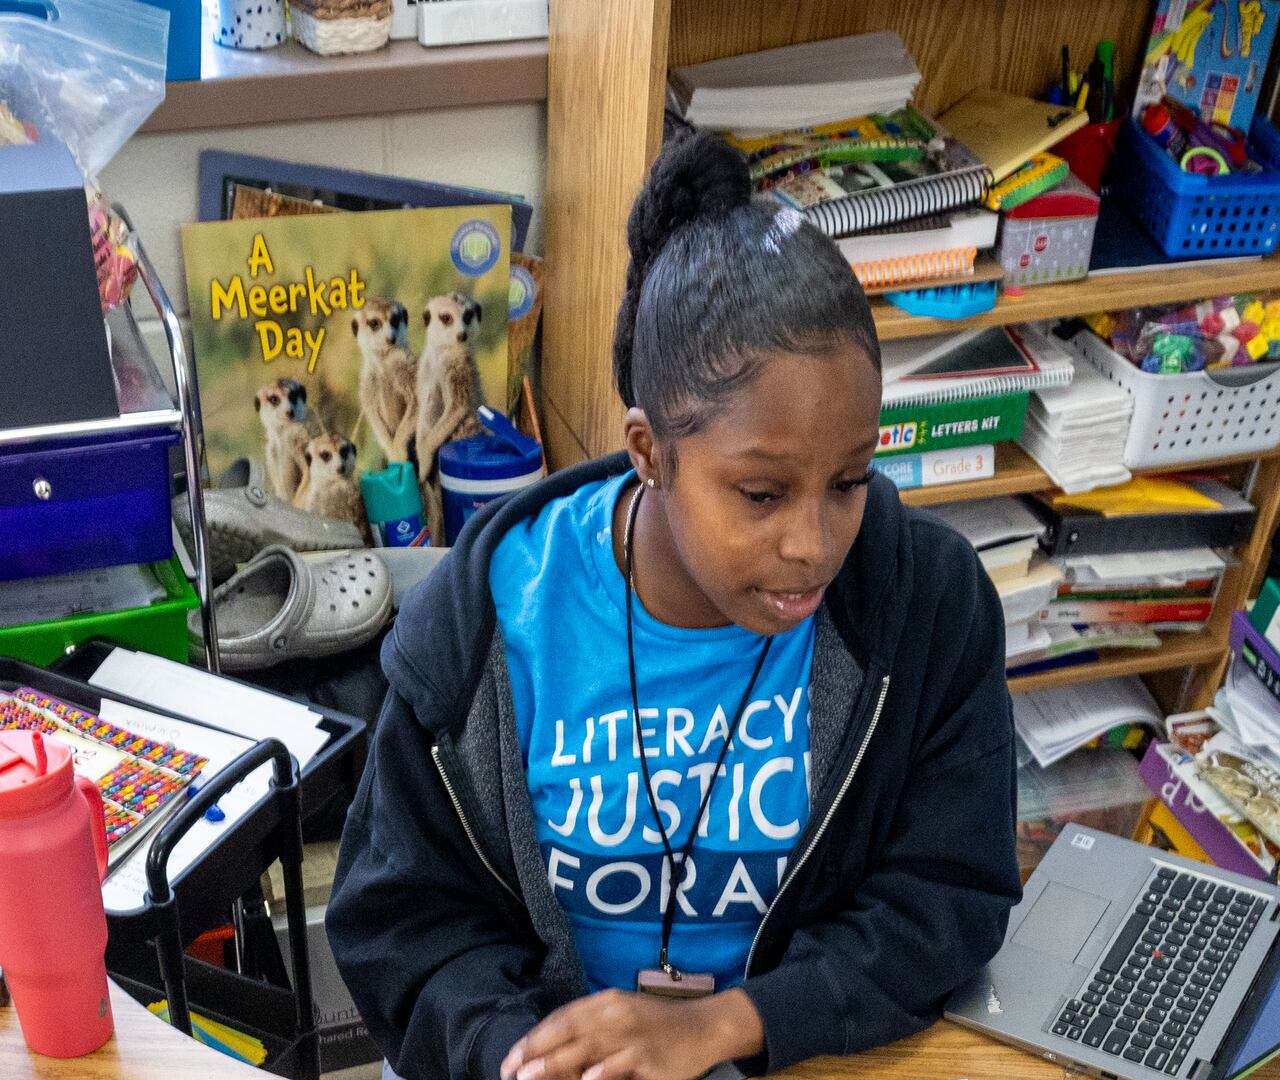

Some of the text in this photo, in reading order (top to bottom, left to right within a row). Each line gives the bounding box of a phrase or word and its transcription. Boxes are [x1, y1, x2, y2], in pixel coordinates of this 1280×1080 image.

[249, 234, 274, 276] A
[211, 267, 365, 320] Meerkat
[255, 320, 326, 373] Day
[931, 420, 978, 437] LETTERS
[885, 462, 912, 475] CORE
[934, 455, 983, 475] Grade 3
[551, 687, 802, 767] LITERACY
[548, 751, 812, 847] JUSTIC
[548, 847, 697, 916] FOR
